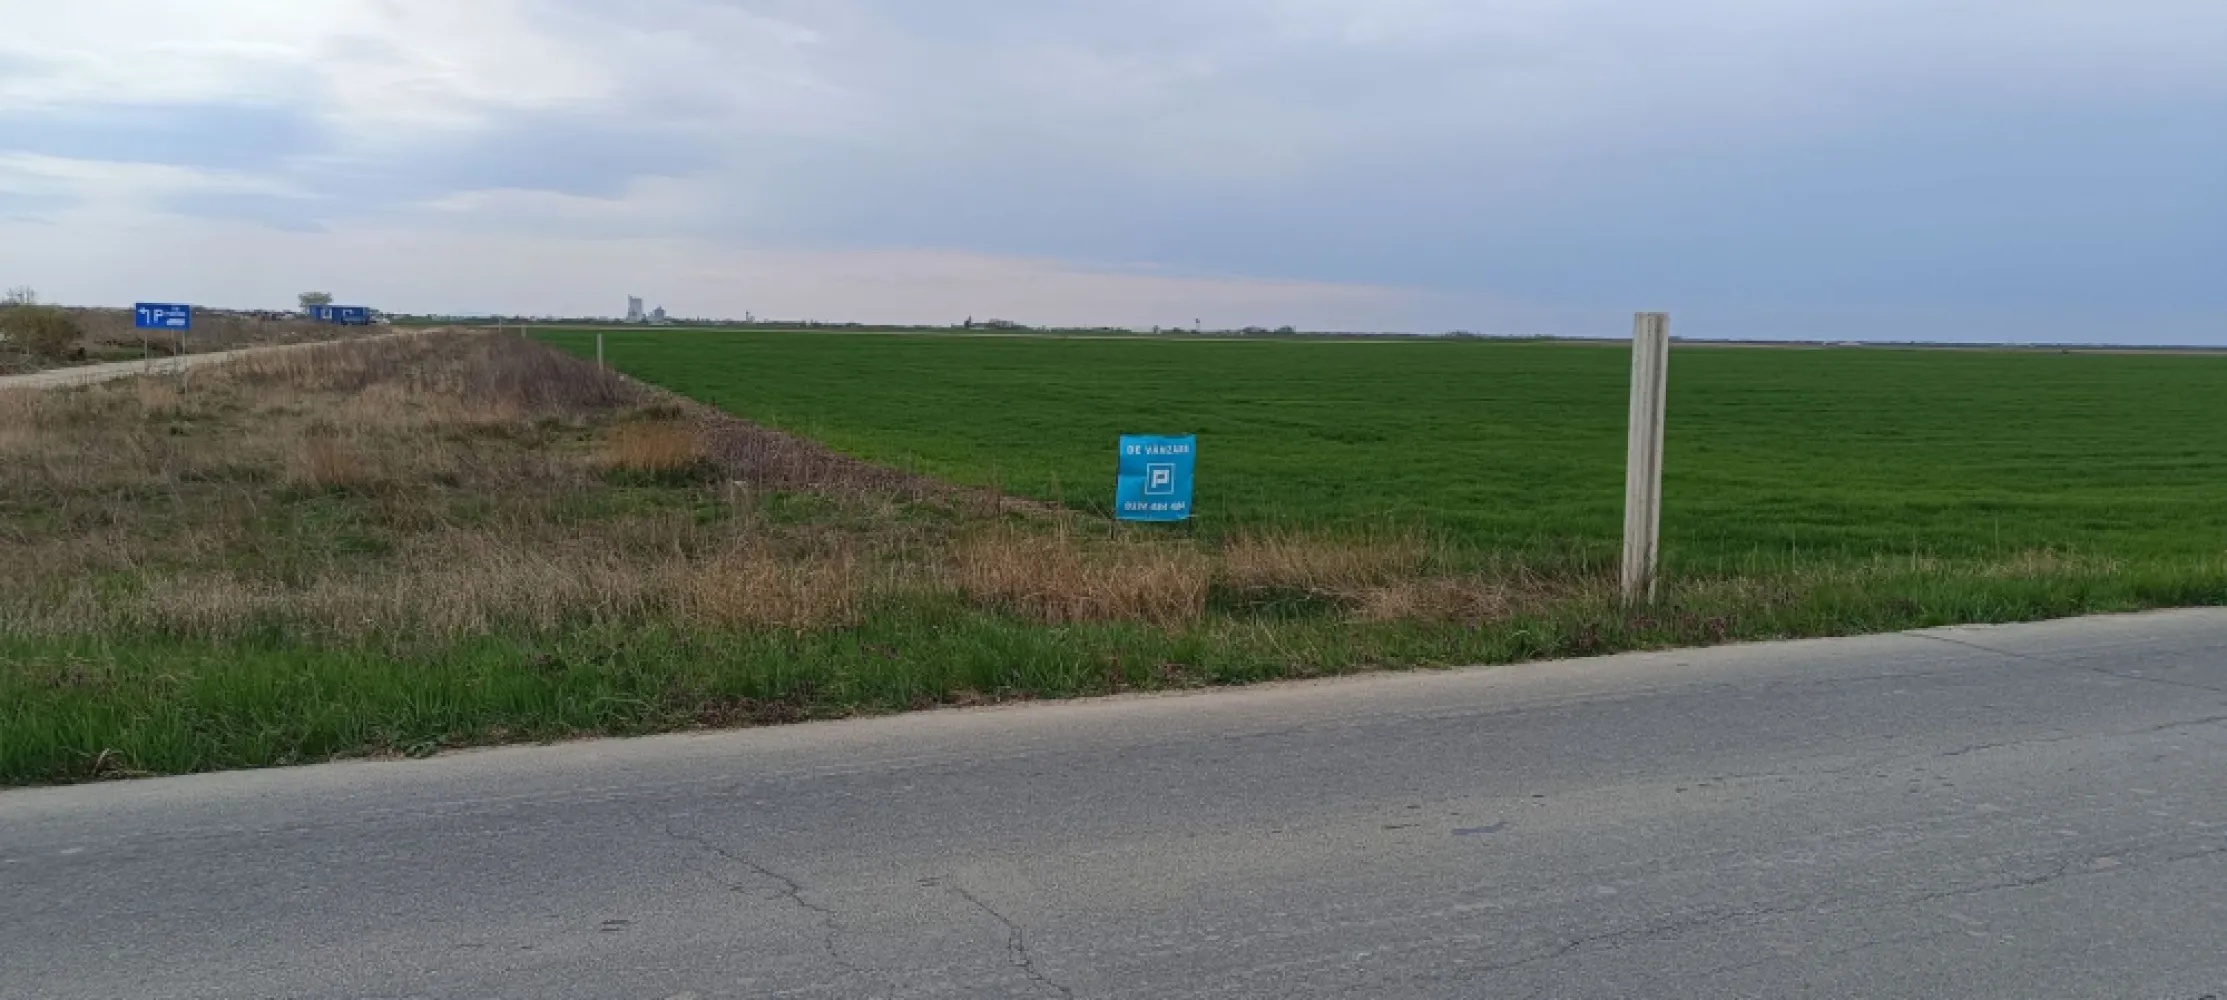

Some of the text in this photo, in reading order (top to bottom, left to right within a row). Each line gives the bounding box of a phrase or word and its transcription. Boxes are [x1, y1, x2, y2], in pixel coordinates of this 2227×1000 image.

[153, 308, 163, 324] P
[1126, 444, 1141, 455] DE
[1150, 469, 1170, 489] P
